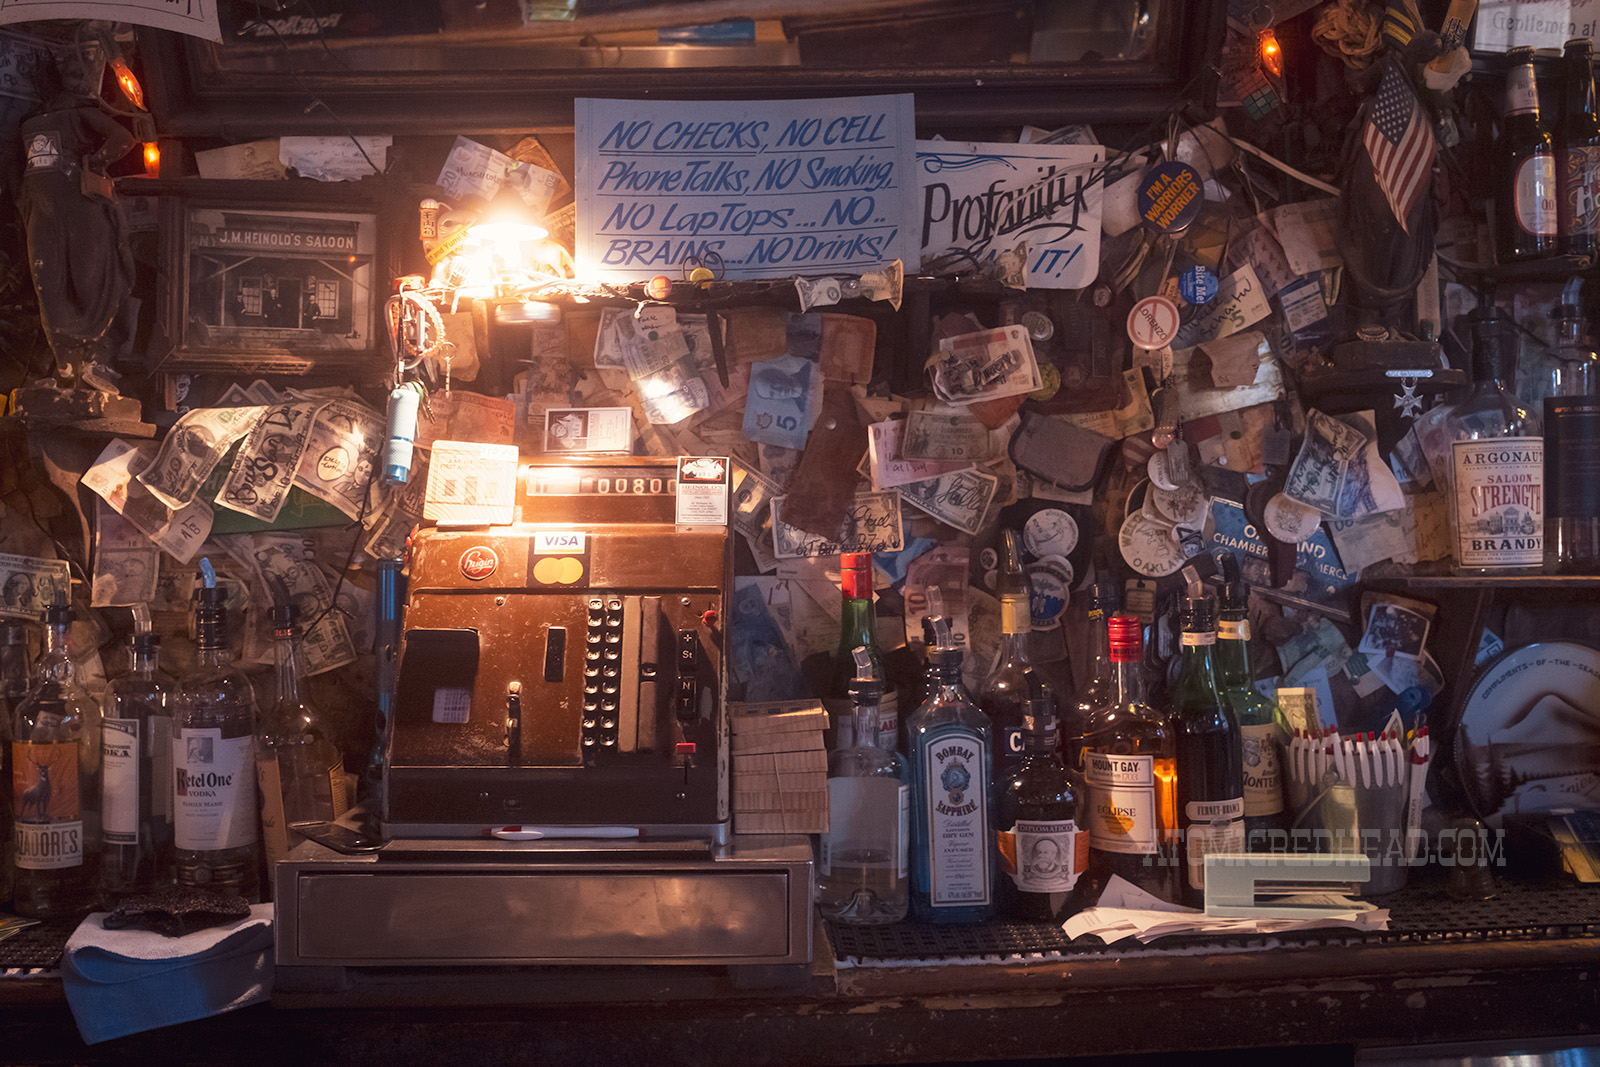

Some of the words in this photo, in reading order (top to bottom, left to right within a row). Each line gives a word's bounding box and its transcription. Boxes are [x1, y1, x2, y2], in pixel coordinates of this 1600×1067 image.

[598, 120, 654, 150] NO
[652, 120, 769, 154] CHECKS,
[775, 118, 822, 147] NO
[823, 113, 886, 145] CELL
[752, 159, 801, 191] NO
[800, 155, 894, 192] Smoking,
[1144, 169, 1193, 223] WARRIORS
[1145, 180, 1164, 202] I'M
[1161, 172, 1173, 187] A
[1156, 181, 1201, 230] WORRIER
[601, 202, 655, 231] NO
[305, 235, 354, 250] SALOON
[744, 237, 794, 264] NO
[792, 228, 898, 261] Drinks!
[1031, 243, 1084, 278] IT!
[1195, 265, 1206, 288] Bite
[1195, 287, 1206, 305] Me!
[1138, 306, 1168, 342] LORENZO
[776, 415, 797, 432] 5
[1487, 474, 1532, 484] SALOON
[545, 535, 579, 547] VISA
[1213, 532, 1269, 557] CHAMBER
[953, 633, 966, 646] 10
[682, 650, 693, 659] St
[682, 682, 691, 690] N
[935, 746, 975, 764] BOMBAY
[1092, 759, 1118, 772] MOUNT
[1120, 762, 1139, 773] GAY
[206, 773, 233, 788] One
[935, 799, 979, 817] SAPPHIRE
[1097, 806, 1137, 818] ECLIPSE
